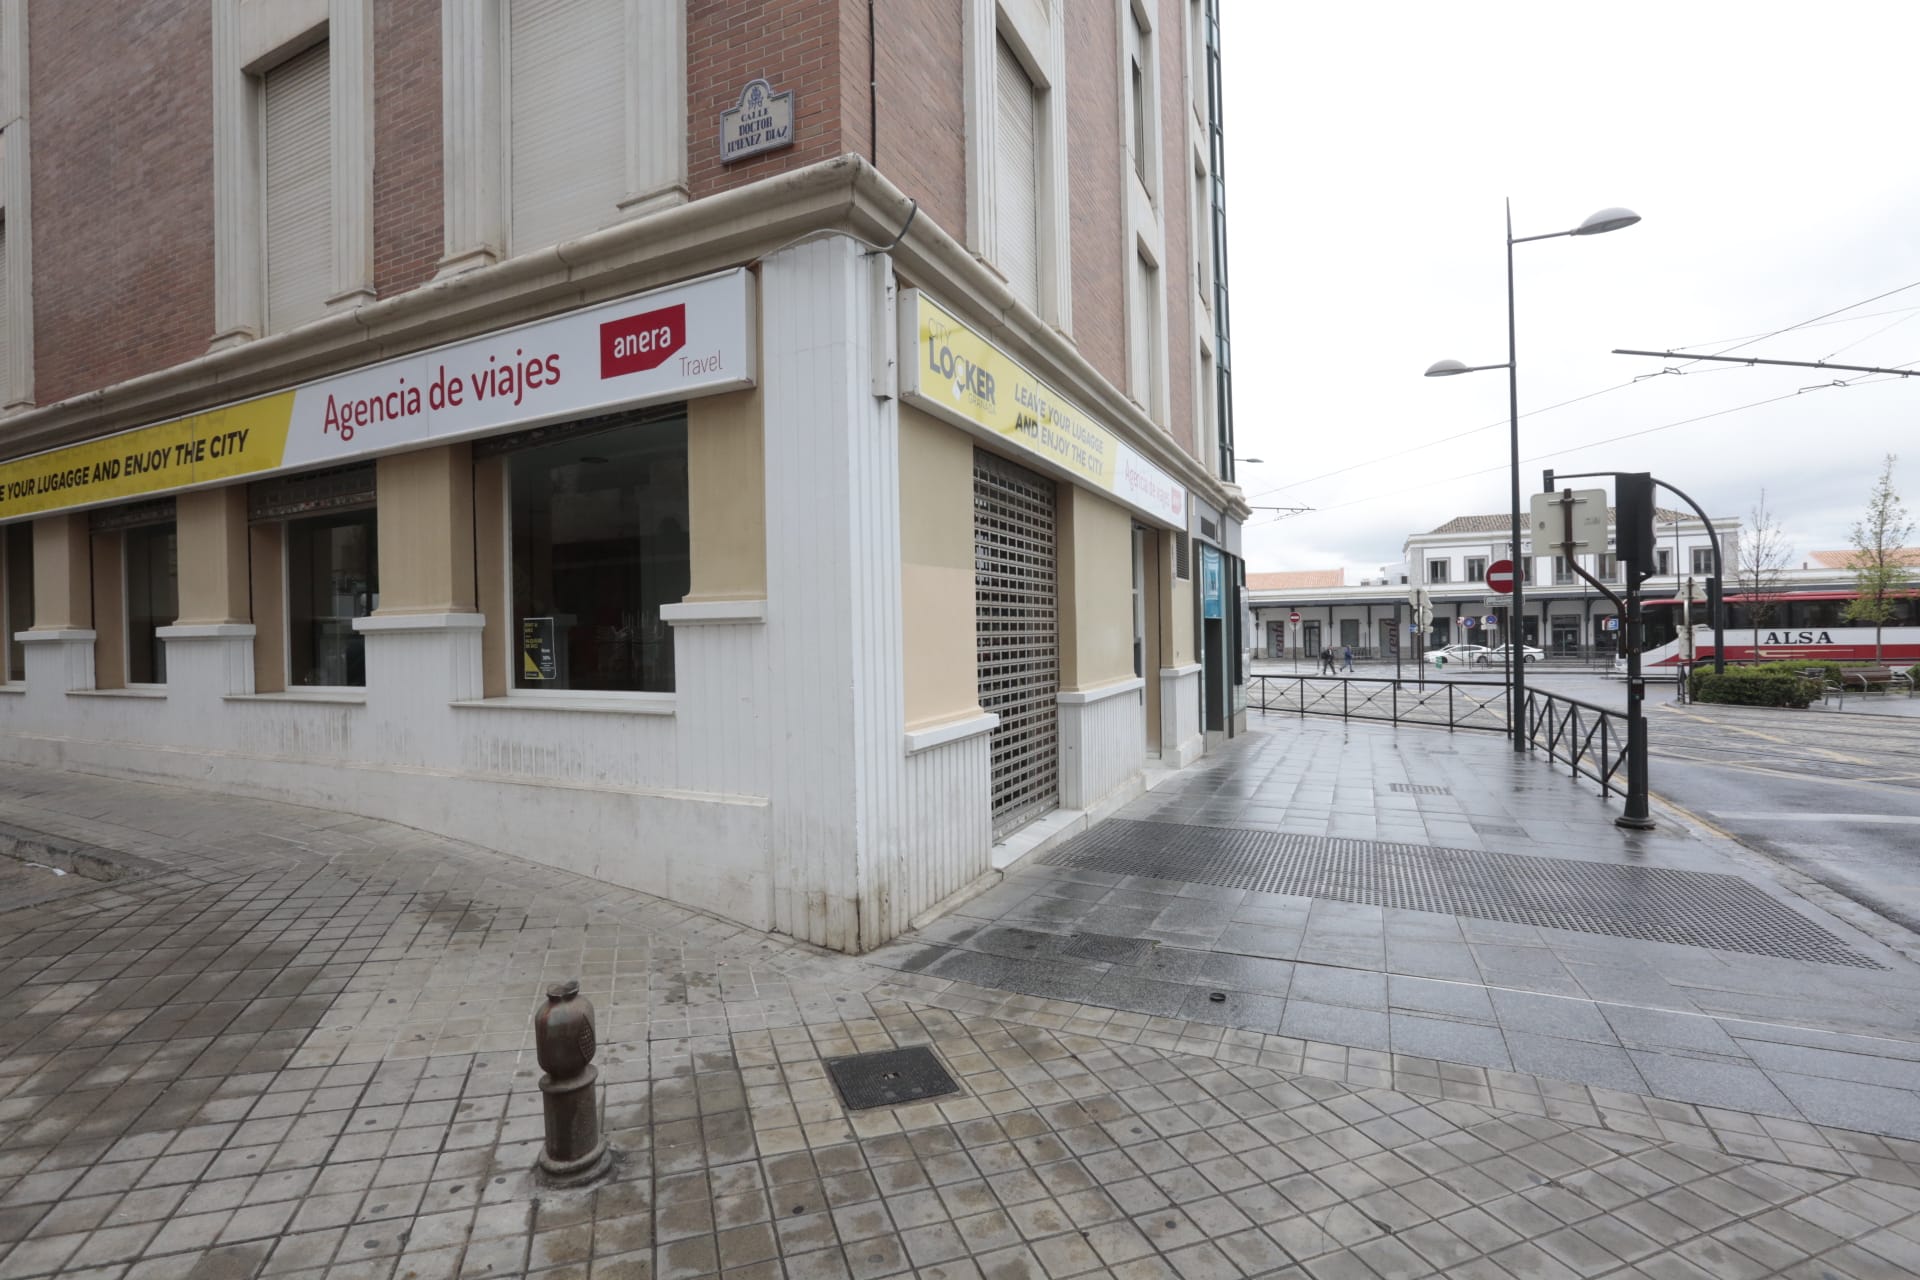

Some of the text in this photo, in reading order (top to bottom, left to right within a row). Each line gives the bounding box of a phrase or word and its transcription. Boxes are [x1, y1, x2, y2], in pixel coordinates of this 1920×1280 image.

[739, 116, 772, 136] DOCTOR
[613, 326, 671, 358] anera
[679, 350, 722, 376] Travel
[323, 349, 561, 441] Agencia de viajes
[929, 336, 996, 405] LOCKER
[1014, 383, 1046, 418] LEAVE
[1048, 404, 1071, 433] YOUR
[7, 478, 35, 500] YOUR
[37, 466, 90, 494] LUGAGGE
[92, 459, 121, 483] AND
[124, 446, 172, 476] ENJOY
[175, 439, 206, 466] THE
[210, 429, 249, 458] CITY
[1015, 412, 1105, 476] AND ENJOY THE CITY
[1764, 631, 1835, 645] ALSA
